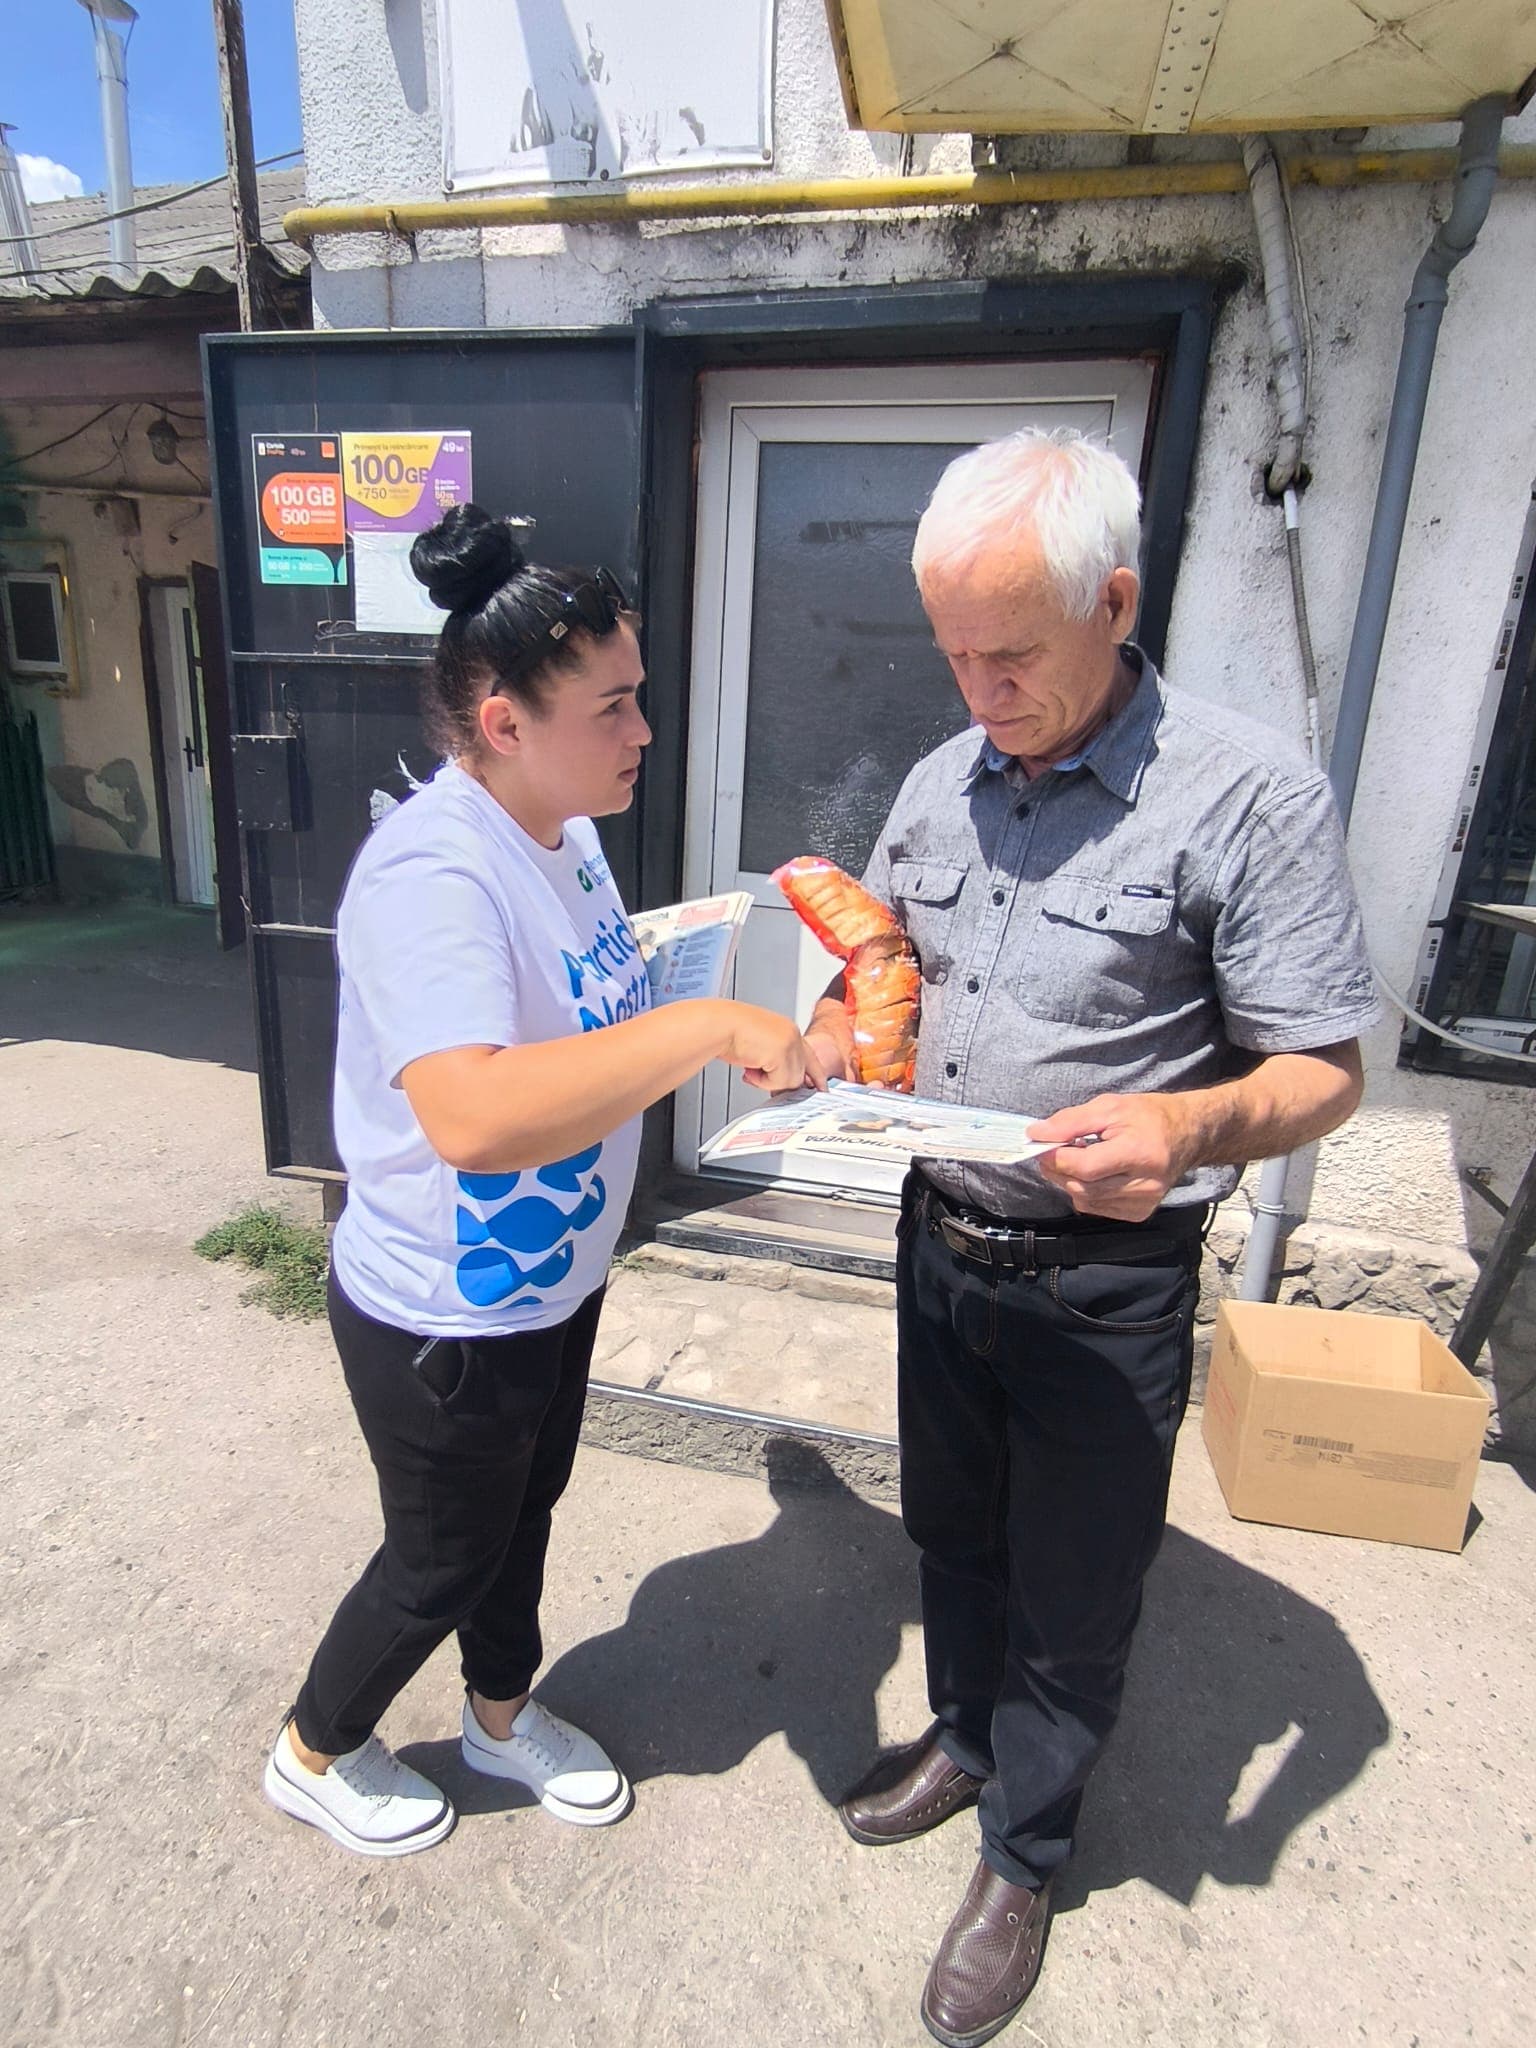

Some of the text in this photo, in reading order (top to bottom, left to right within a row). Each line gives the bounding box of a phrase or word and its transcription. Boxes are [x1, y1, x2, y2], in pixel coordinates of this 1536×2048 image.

[271, 485, 336, 506] 100 GB
[804, 1135, 890, 1148] ПИОНЕРА
